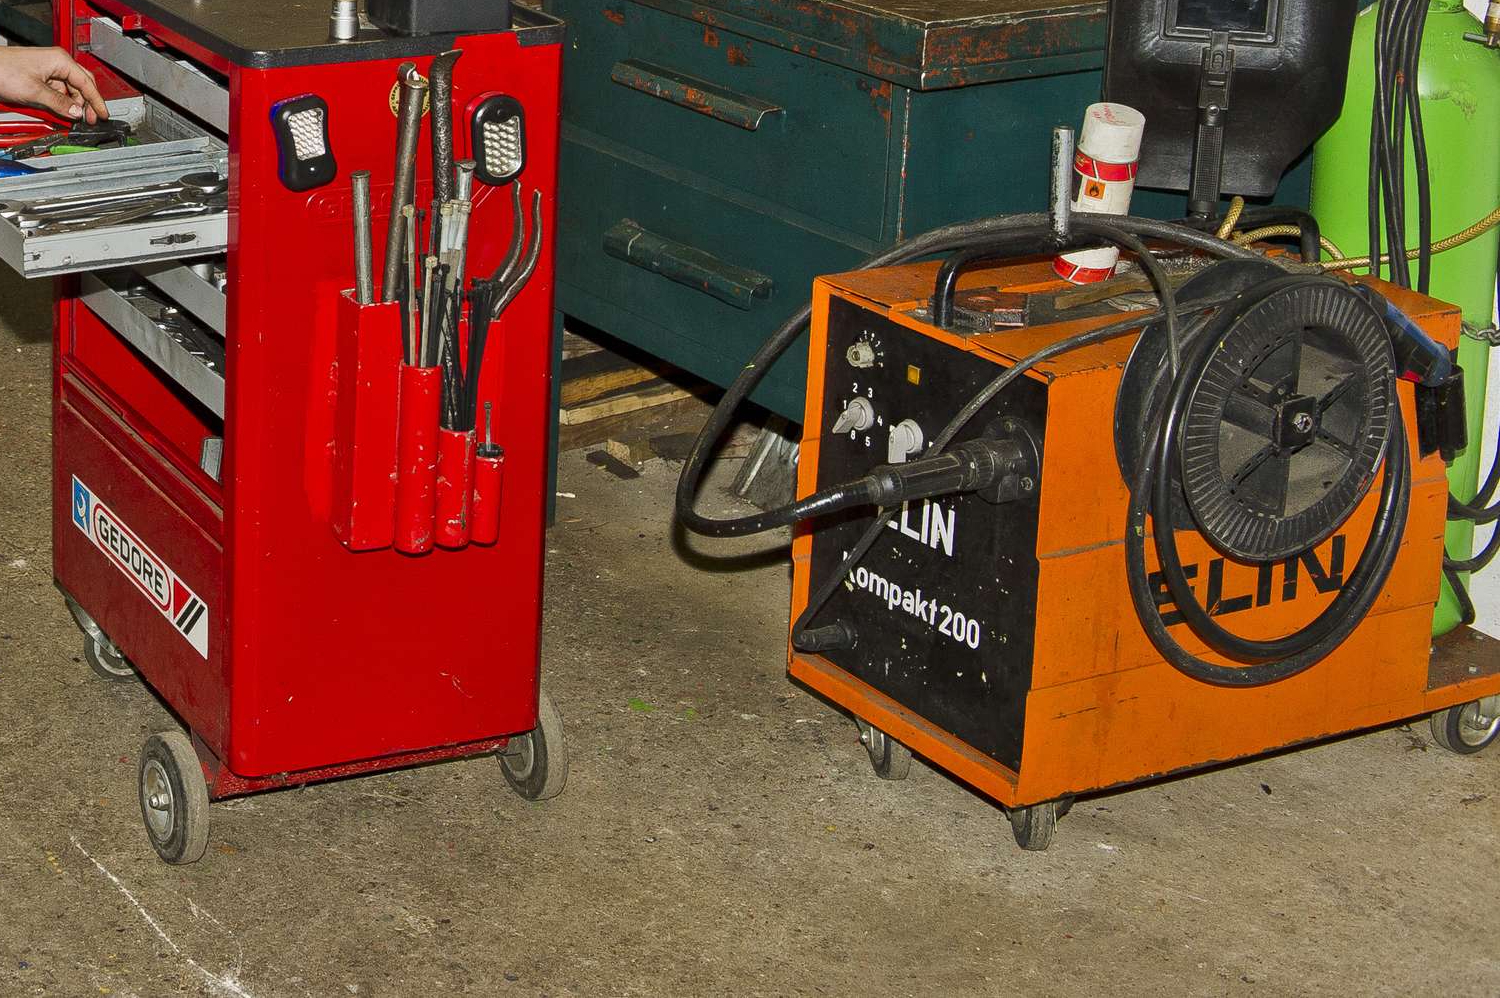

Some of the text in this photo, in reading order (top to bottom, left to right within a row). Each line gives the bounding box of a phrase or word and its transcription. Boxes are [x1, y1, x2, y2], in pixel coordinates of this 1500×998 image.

[852, 382, 858, 393] 2
[867, 387, 873, 399] 3
[843, 399, 847, 410] 1
[877, 415, 883, 427] 4
[865, 435, 871, 447] 5
[885, 498, 955, 557] LIN
[99, 514, 164, 601] GEDORE
